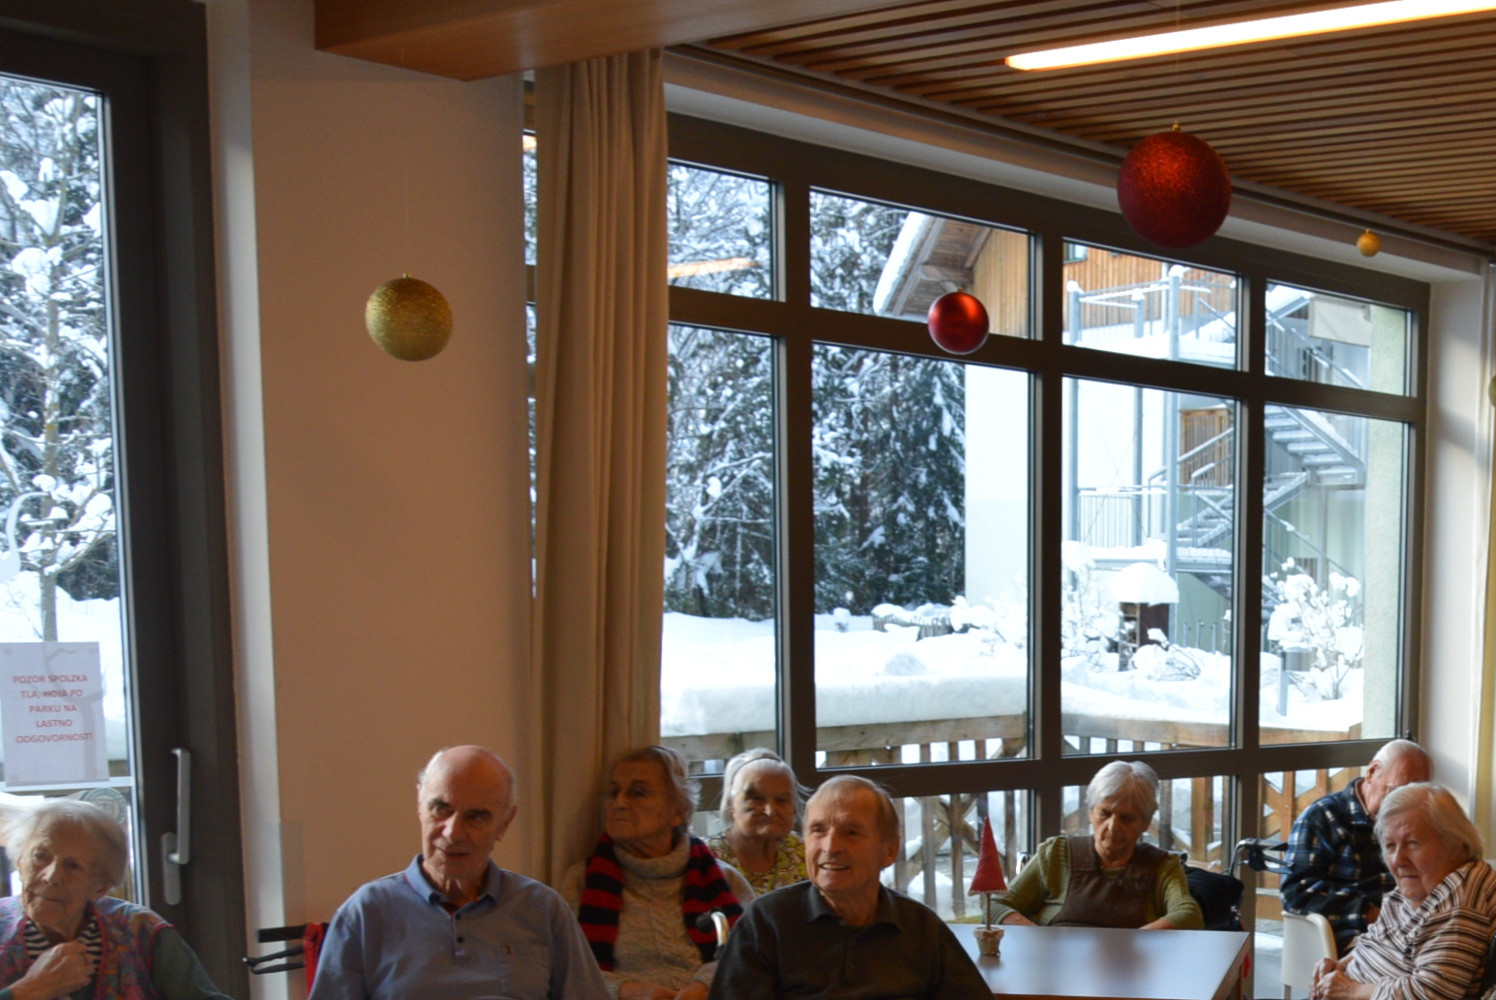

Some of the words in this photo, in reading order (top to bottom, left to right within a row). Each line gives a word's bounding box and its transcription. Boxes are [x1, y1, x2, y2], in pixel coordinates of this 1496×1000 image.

[13, 675, 45, 684] POZOR
[70, 689, 84, 697] PO
[29, 704, 61, 713] PARKU
[63, 704, 77, 712] NA
[35, 719, 73, 728] LASTNO
